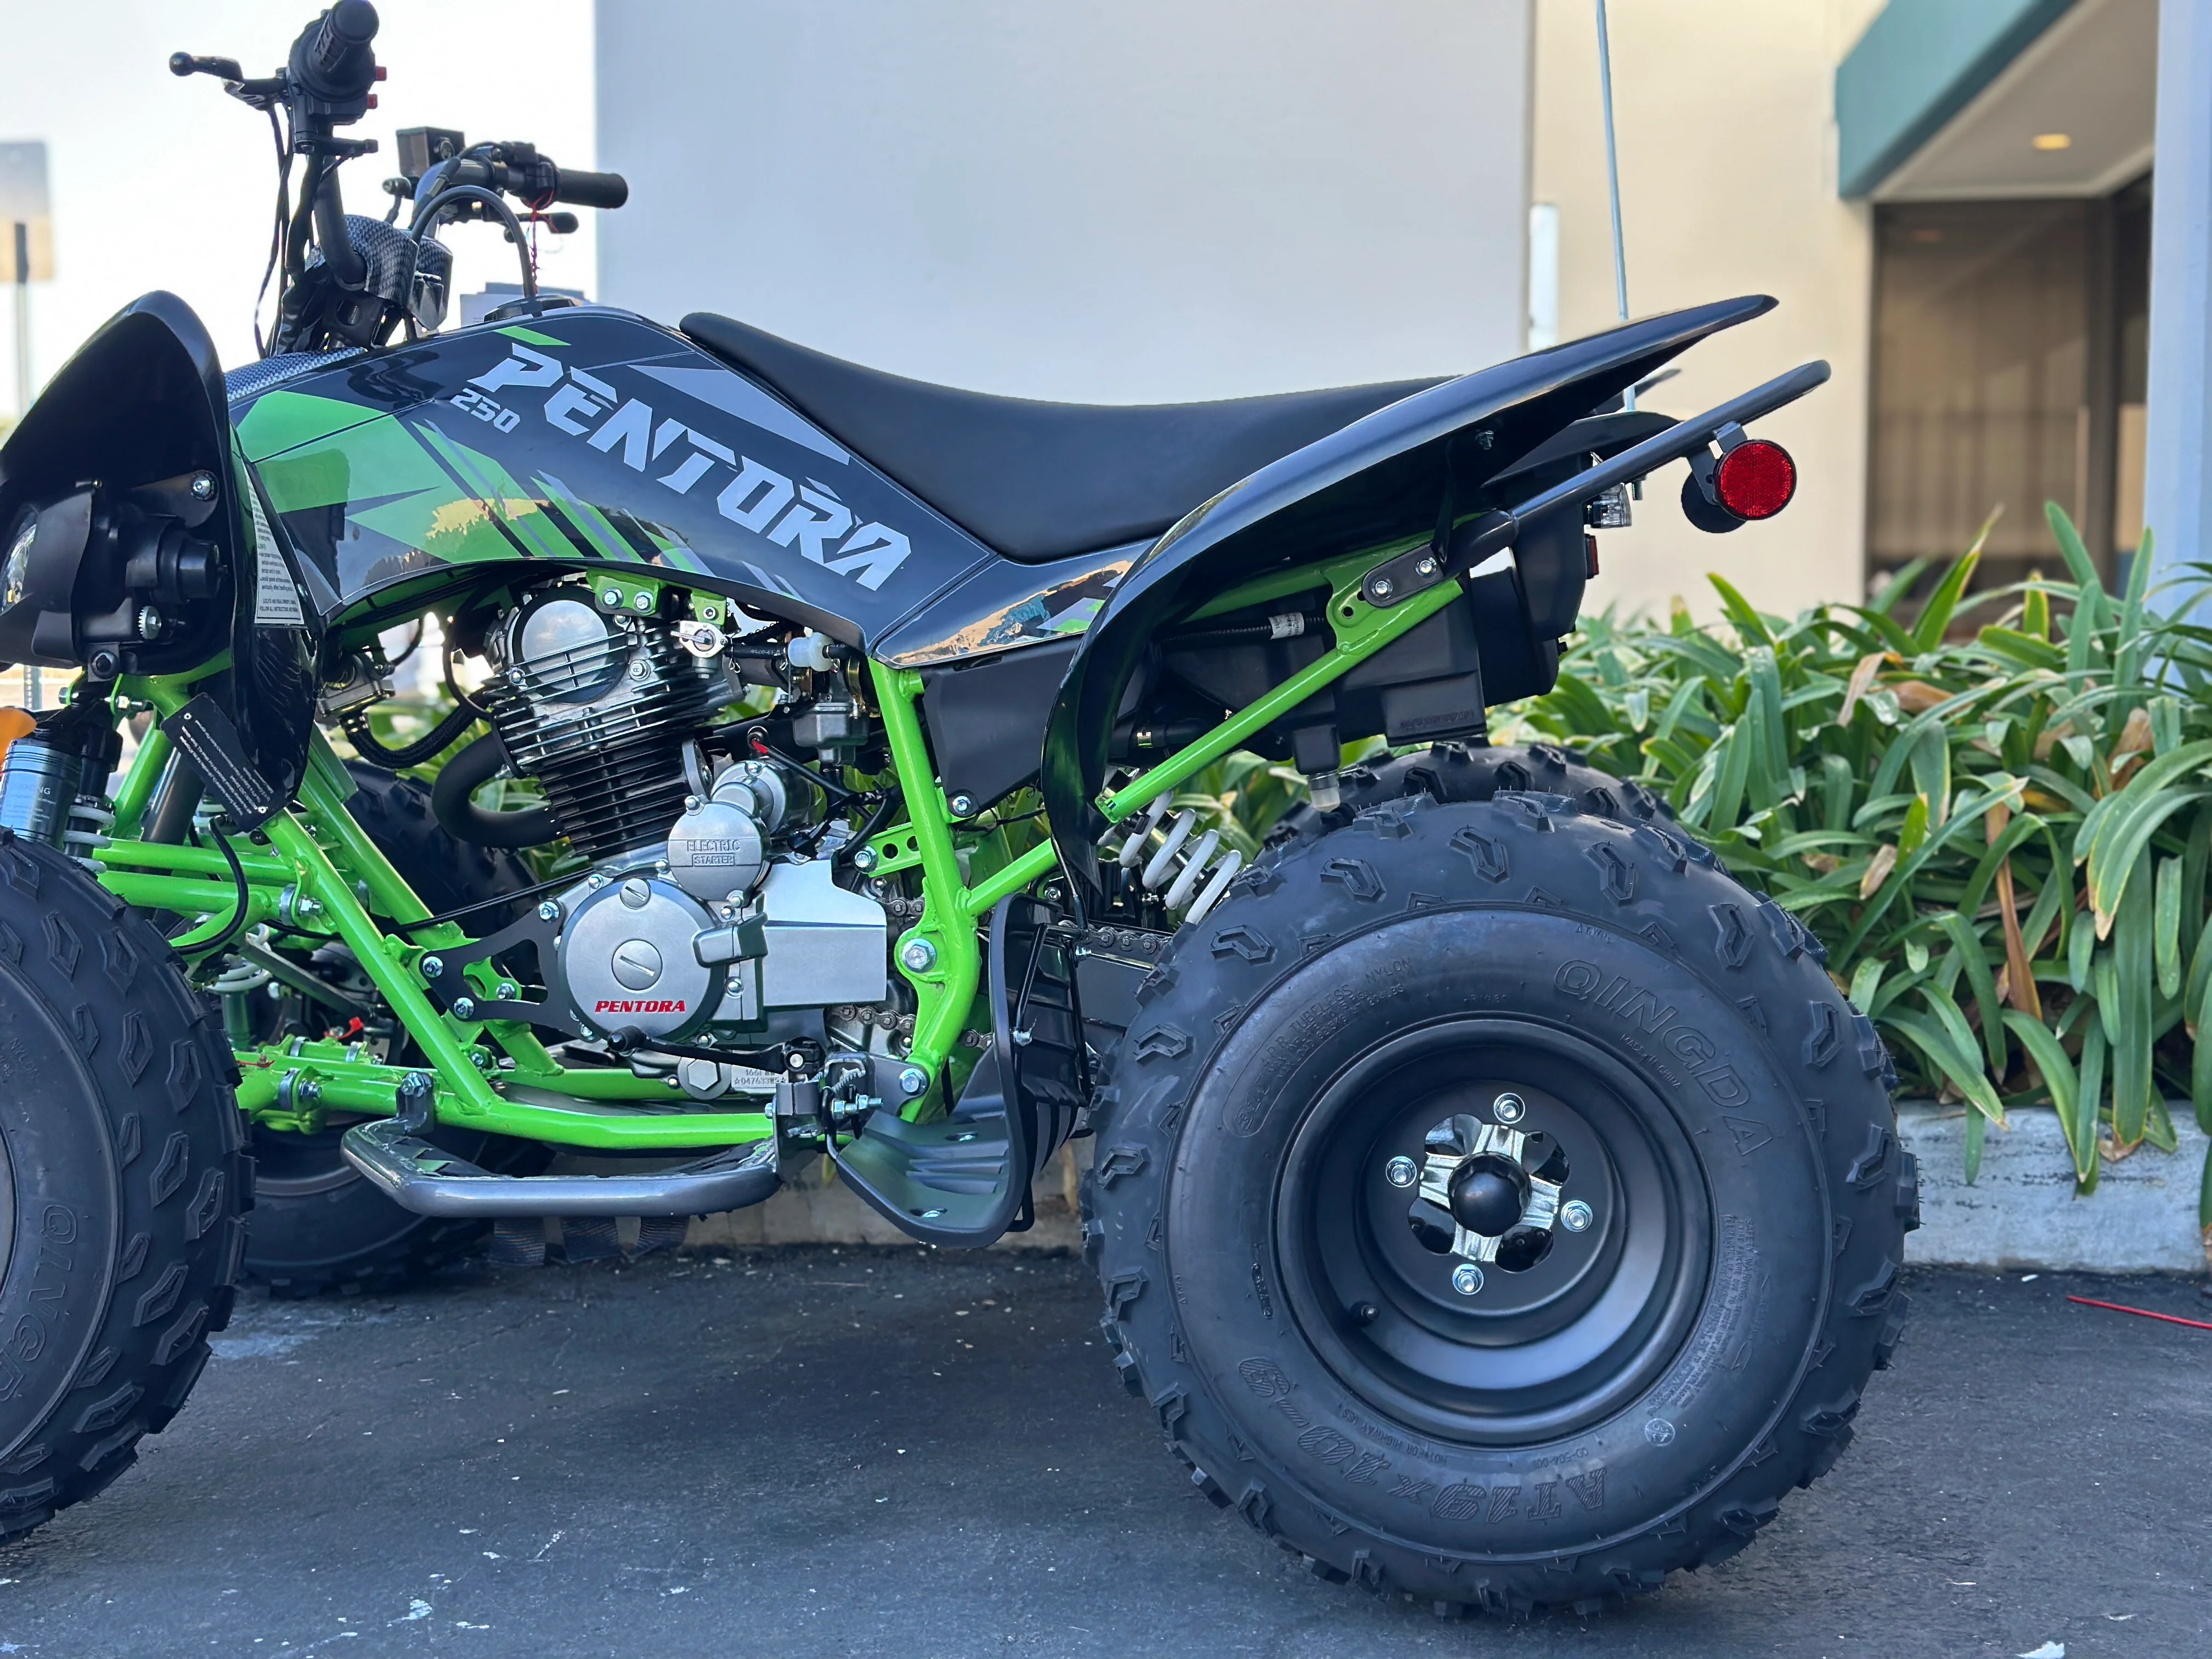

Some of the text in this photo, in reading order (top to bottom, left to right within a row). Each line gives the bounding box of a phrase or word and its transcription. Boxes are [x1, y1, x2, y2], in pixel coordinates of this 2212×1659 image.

[450, 387, 520, 433] 250
[467, 342, 911, 591] PENTORA
[687, 839, 741, 853] ELECTRIC
[694, 855, 735, 865] STARTER
[595, 1000, 686, 1014] PENTORA
[1289, 984, 1353, 1034] TUBELESS
[1364, 957, 1413, 985] NYLON
[9, 1037, 41, 1080] NYLON
[1554, 960, 1773, 1155] QINGDA
[1659, 1065, 1682, 1091] CHINA
[1745, 1219, 1754, 1252] SAFETY
[1361, 1422, 1402, 1451] HIGHWAY
[1405, 1443, 1424, 1458] FOR
[1427, 1454, 1447, 1467] NOT
